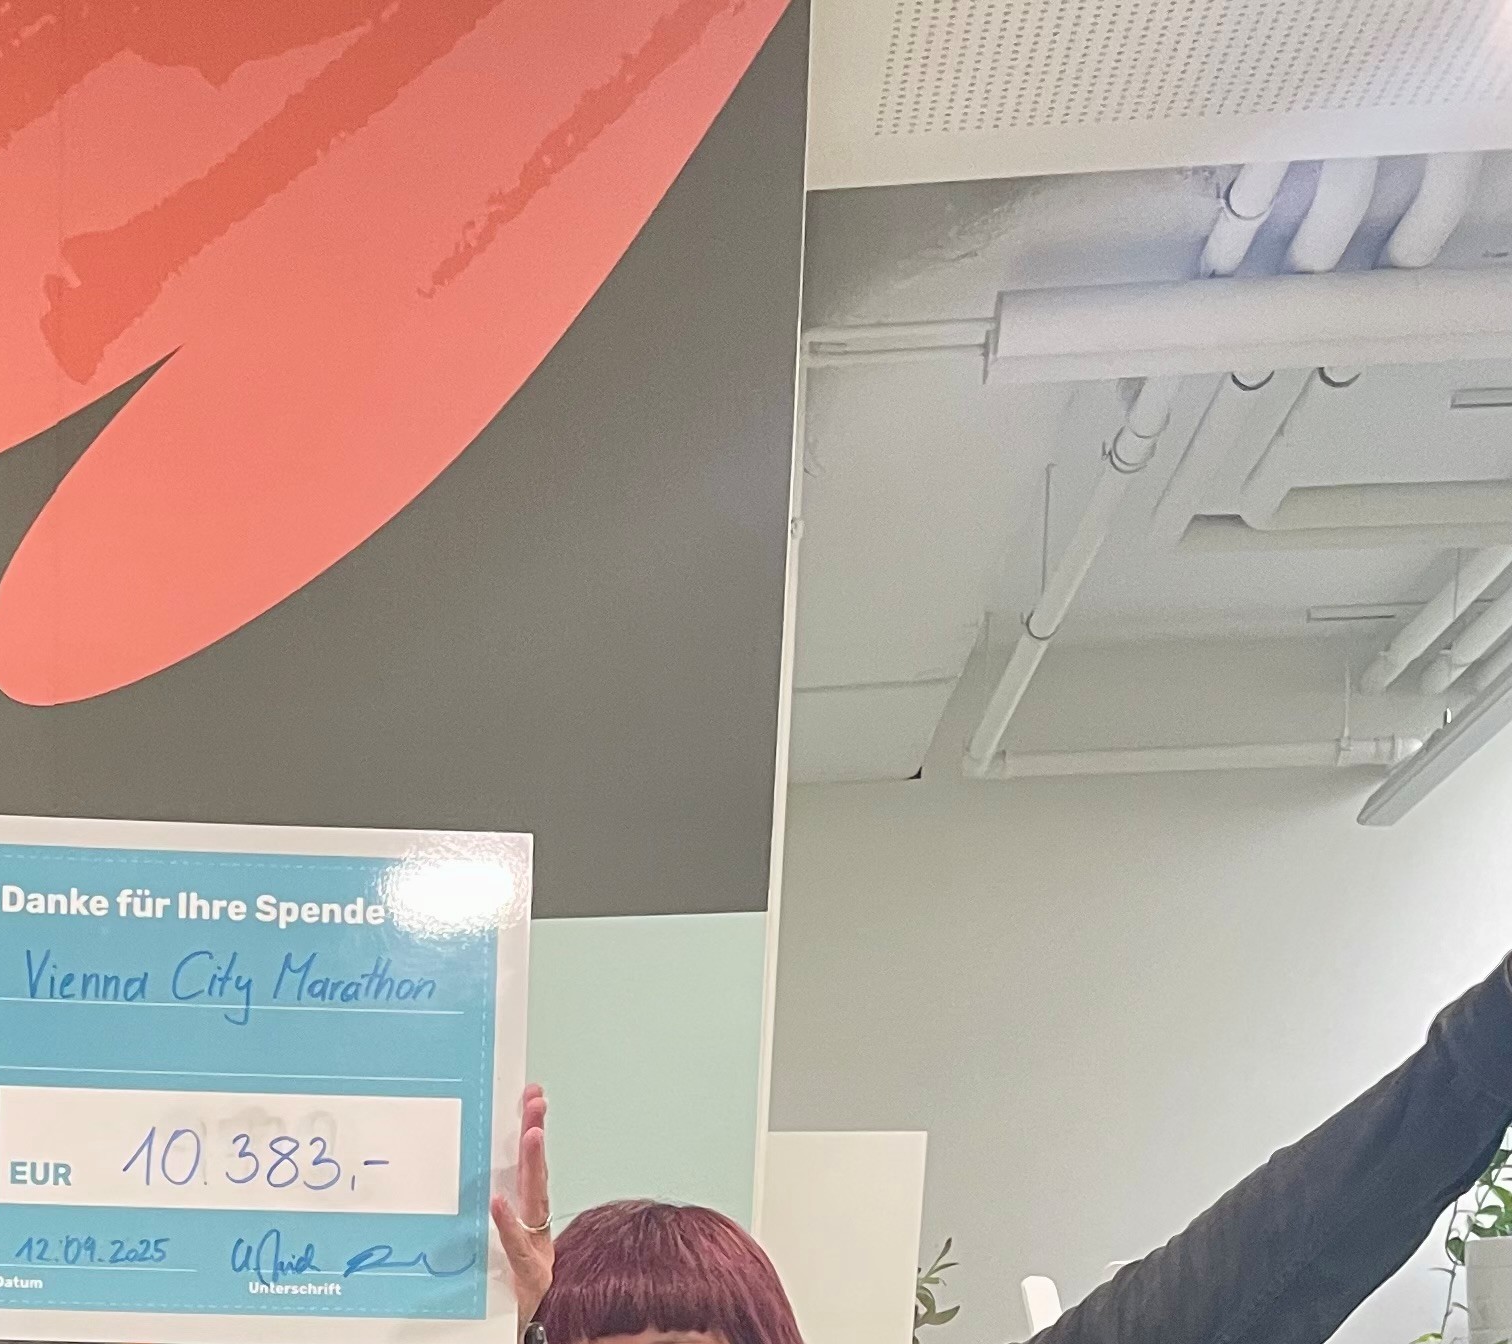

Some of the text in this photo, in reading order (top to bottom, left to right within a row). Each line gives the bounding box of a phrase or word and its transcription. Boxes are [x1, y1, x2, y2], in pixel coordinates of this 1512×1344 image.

[0, 884, 385, 930] Danke für Ihre Spende
[25, 949, 437, 1026] Vienna City Marathon
[9, 1160, 72, 1186] EUR
[248, 1280, 343, 1296] Unterschrift
